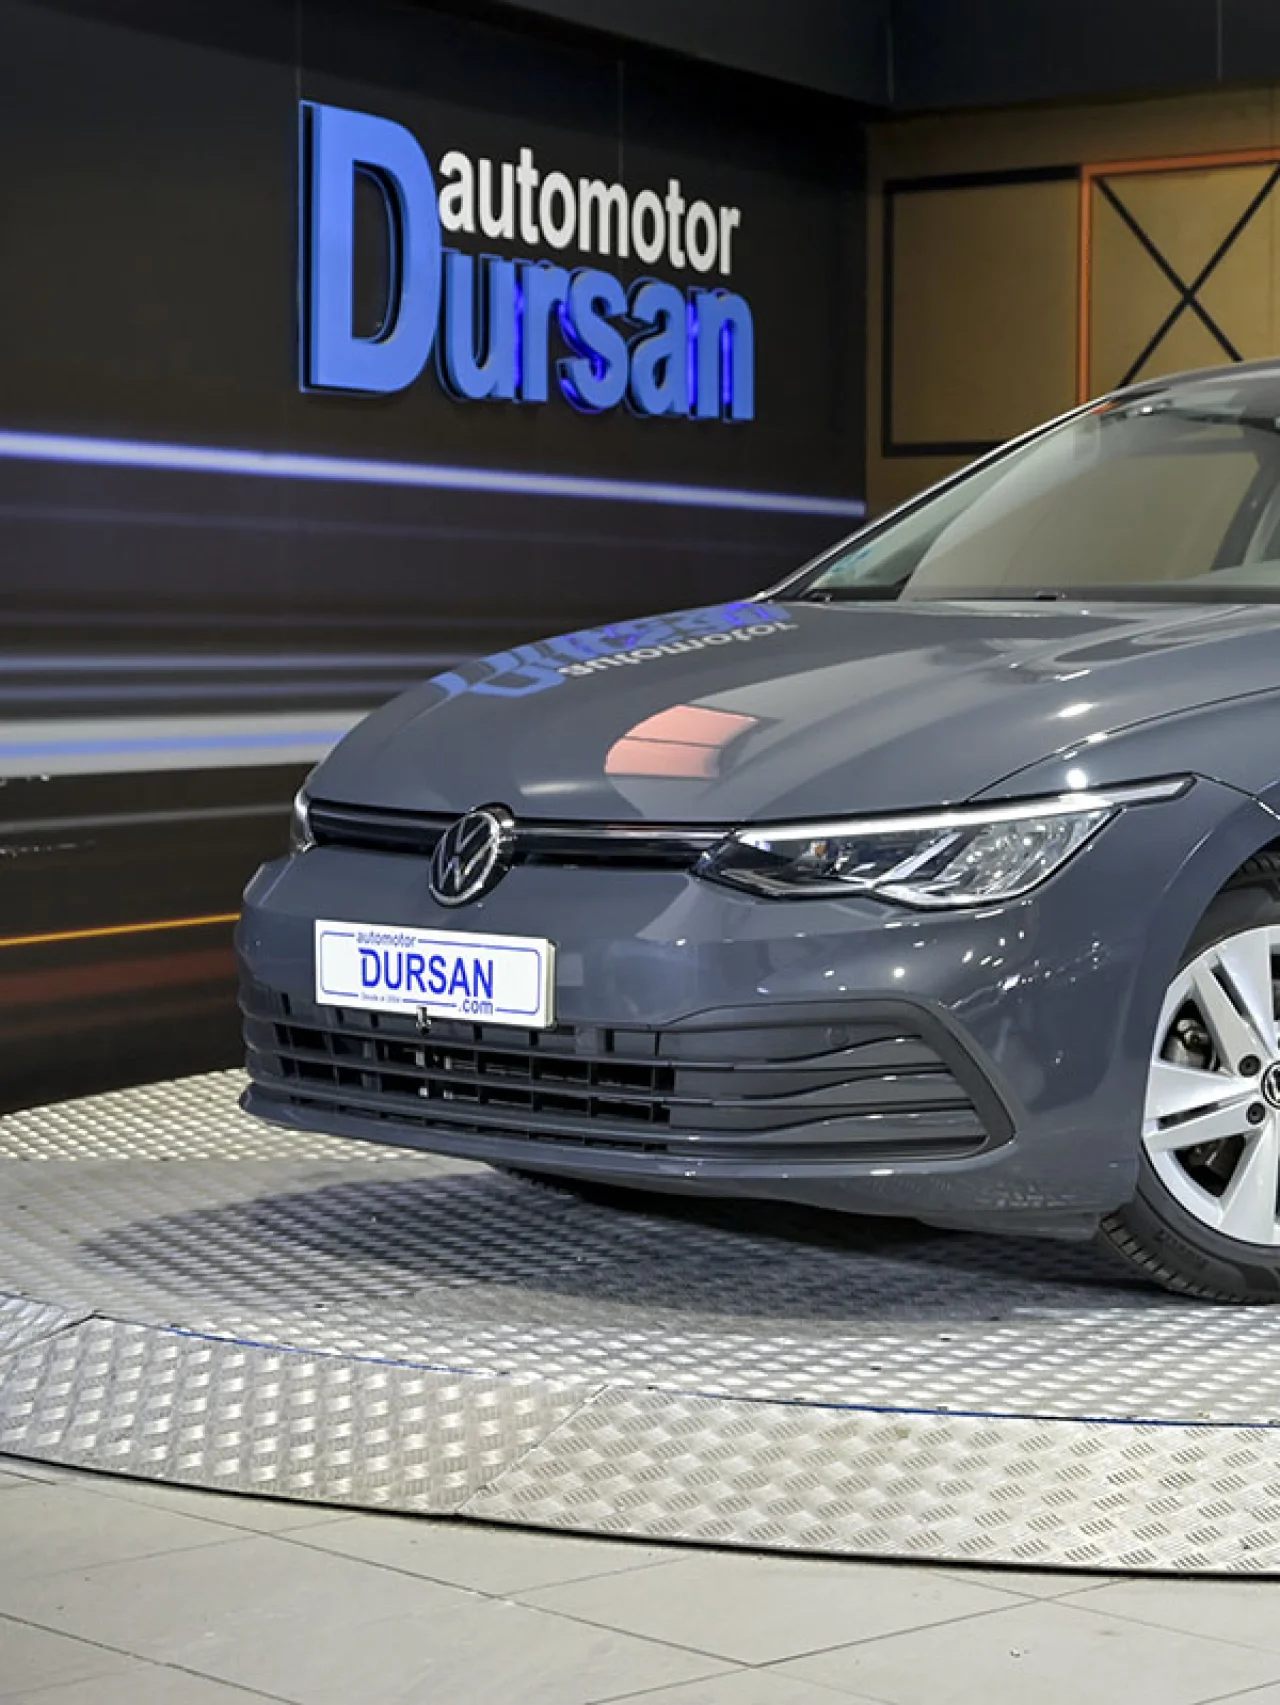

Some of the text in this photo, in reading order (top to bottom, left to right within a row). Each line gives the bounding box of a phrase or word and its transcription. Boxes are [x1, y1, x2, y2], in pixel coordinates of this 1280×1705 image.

[438, 147, 741, 274] automotor
[300, 99, 756, 422] Dursan
[356, 931, 417, 948] automotor
[358, 948, 494, 999] DURSAN
[459, 999, 494, 1016] .com
